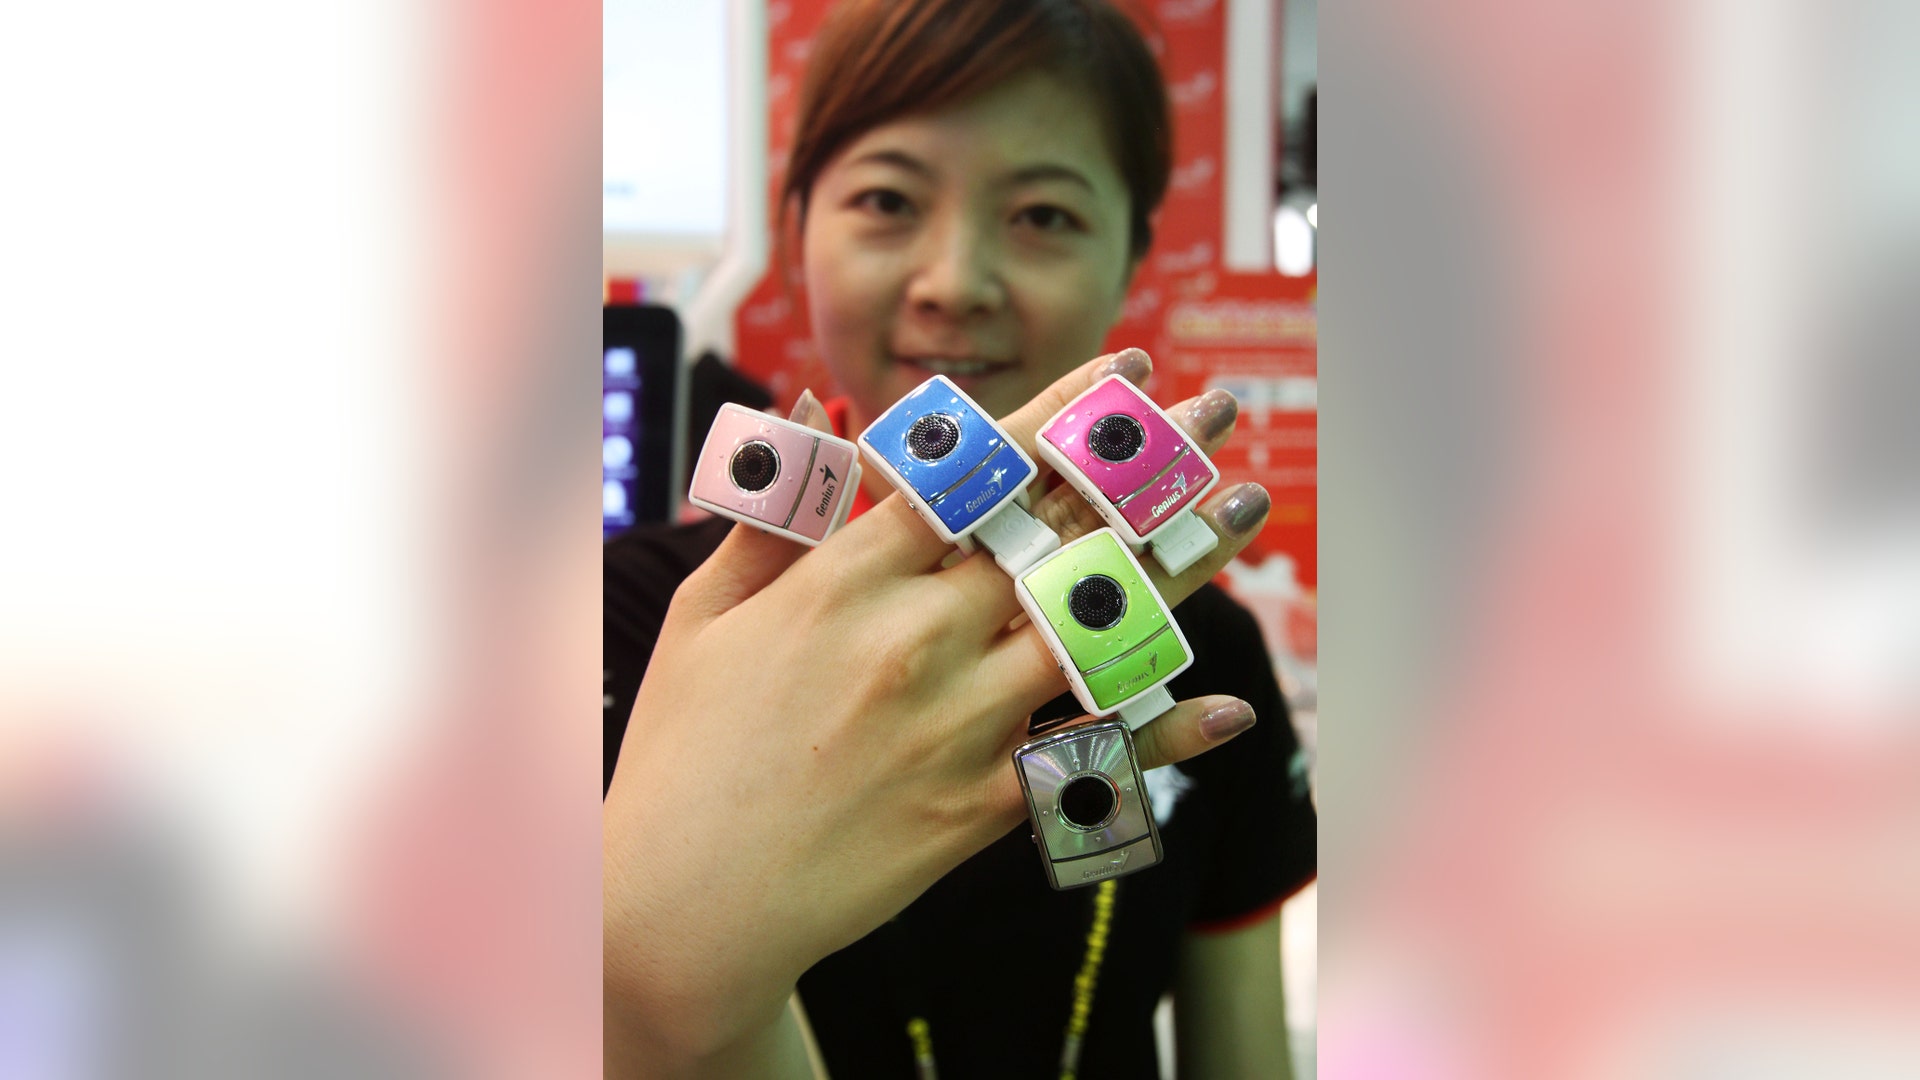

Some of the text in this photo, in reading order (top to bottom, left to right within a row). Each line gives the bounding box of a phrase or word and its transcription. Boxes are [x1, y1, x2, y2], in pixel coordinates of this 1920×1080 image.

[815, 484, 836, 517] Genius
[966, 486, 996, 513] Genius
[1151, 490, 1181, 518] Genius
